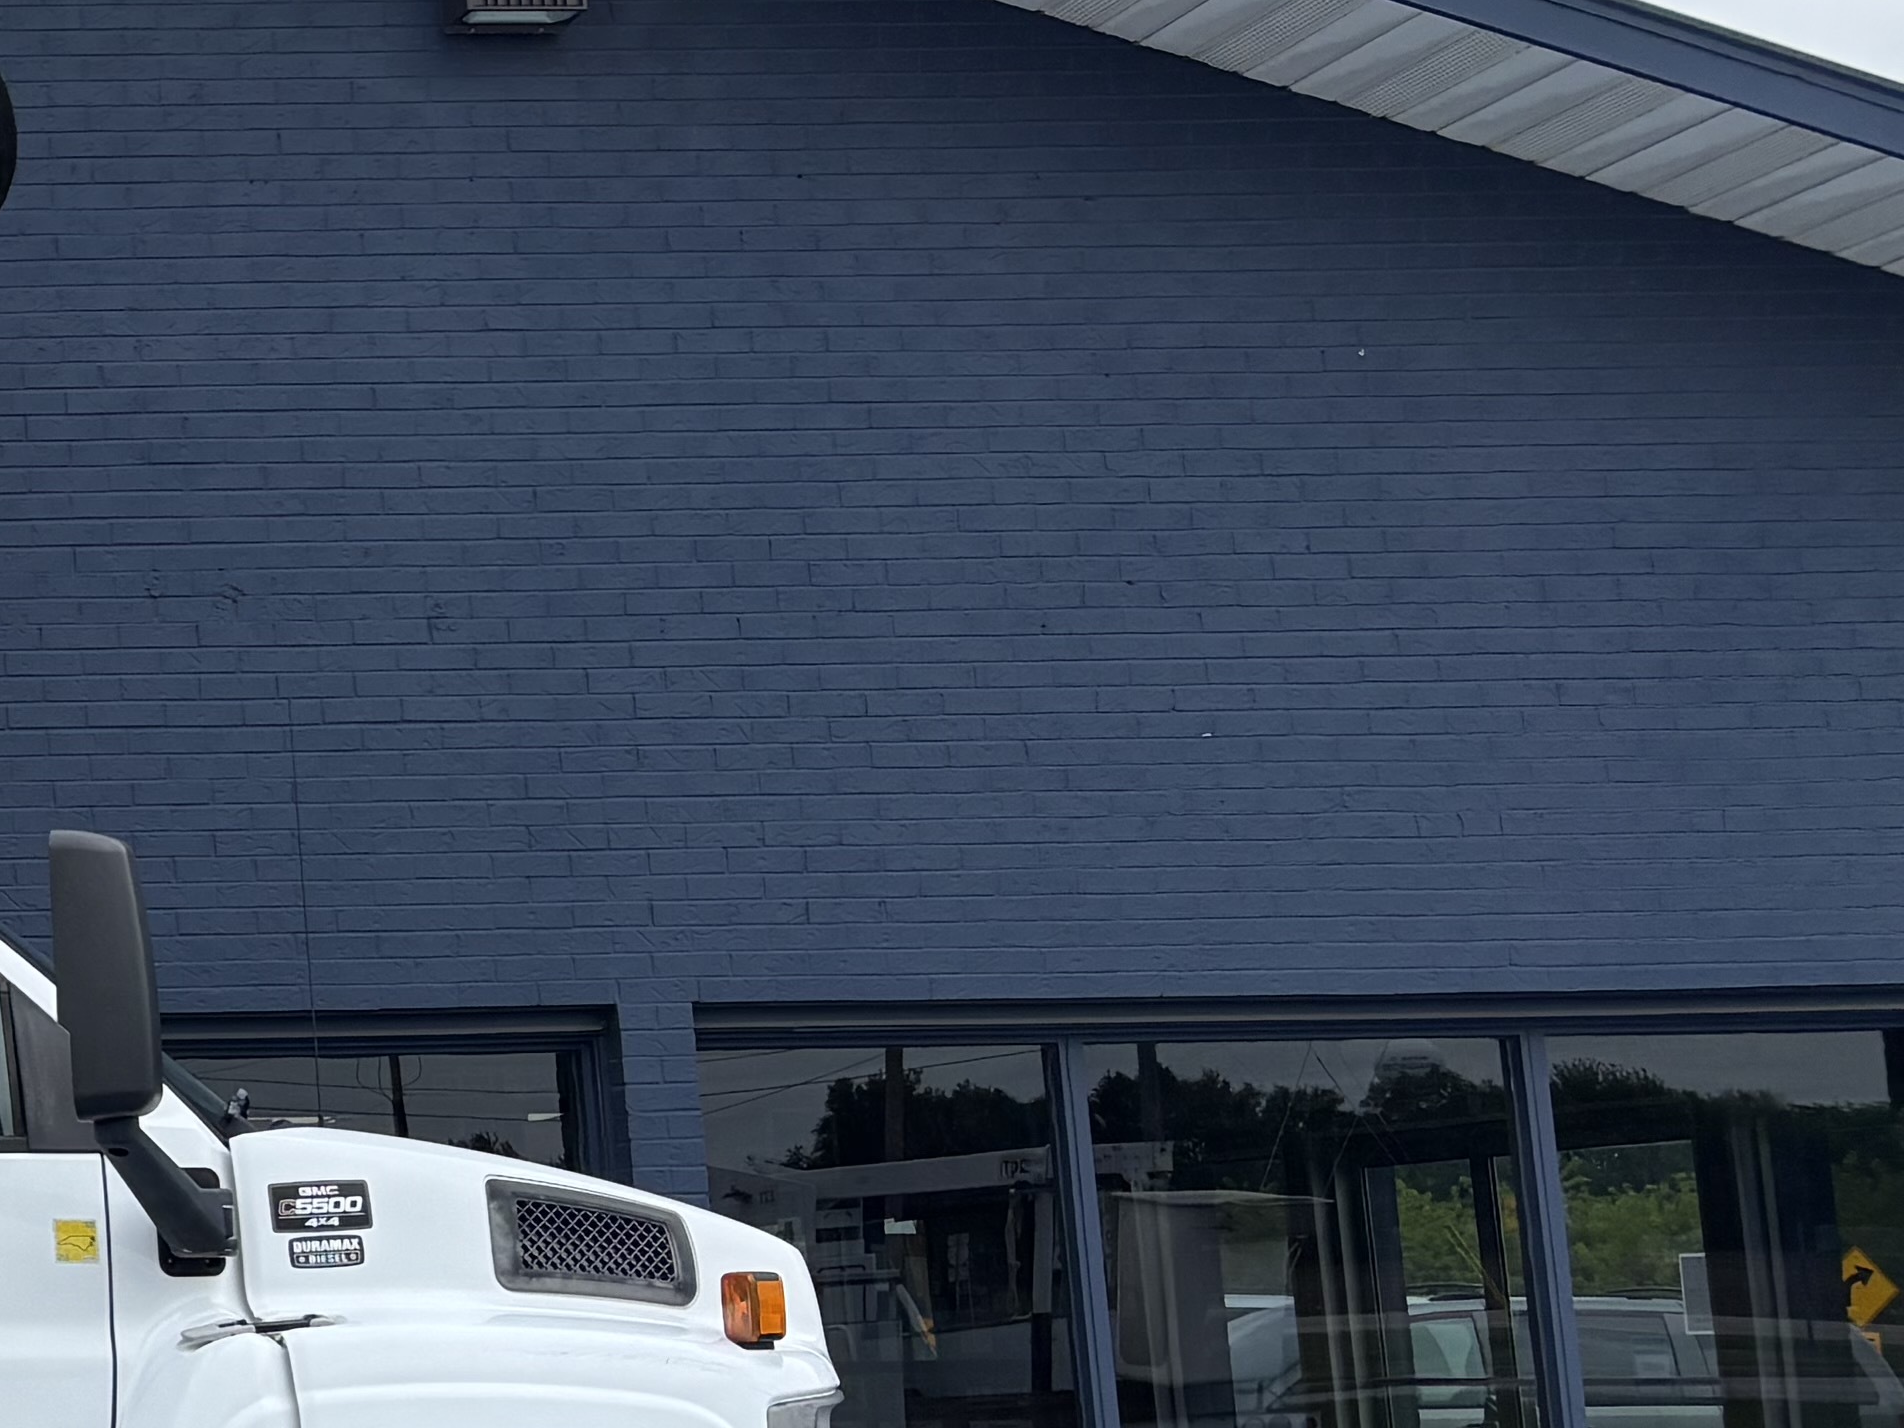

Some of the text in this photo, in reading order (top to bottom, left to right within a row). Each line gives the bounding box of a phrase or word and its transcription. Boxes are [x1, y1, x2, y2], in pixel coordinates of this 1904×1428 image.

[298, 1185, 339, 1196] GMC
[278, 1196, 363, 1216] C5500
[292, 1238, 360, 1253] DURAMAX
[308, 1253, 348, 1264] DIESEL
